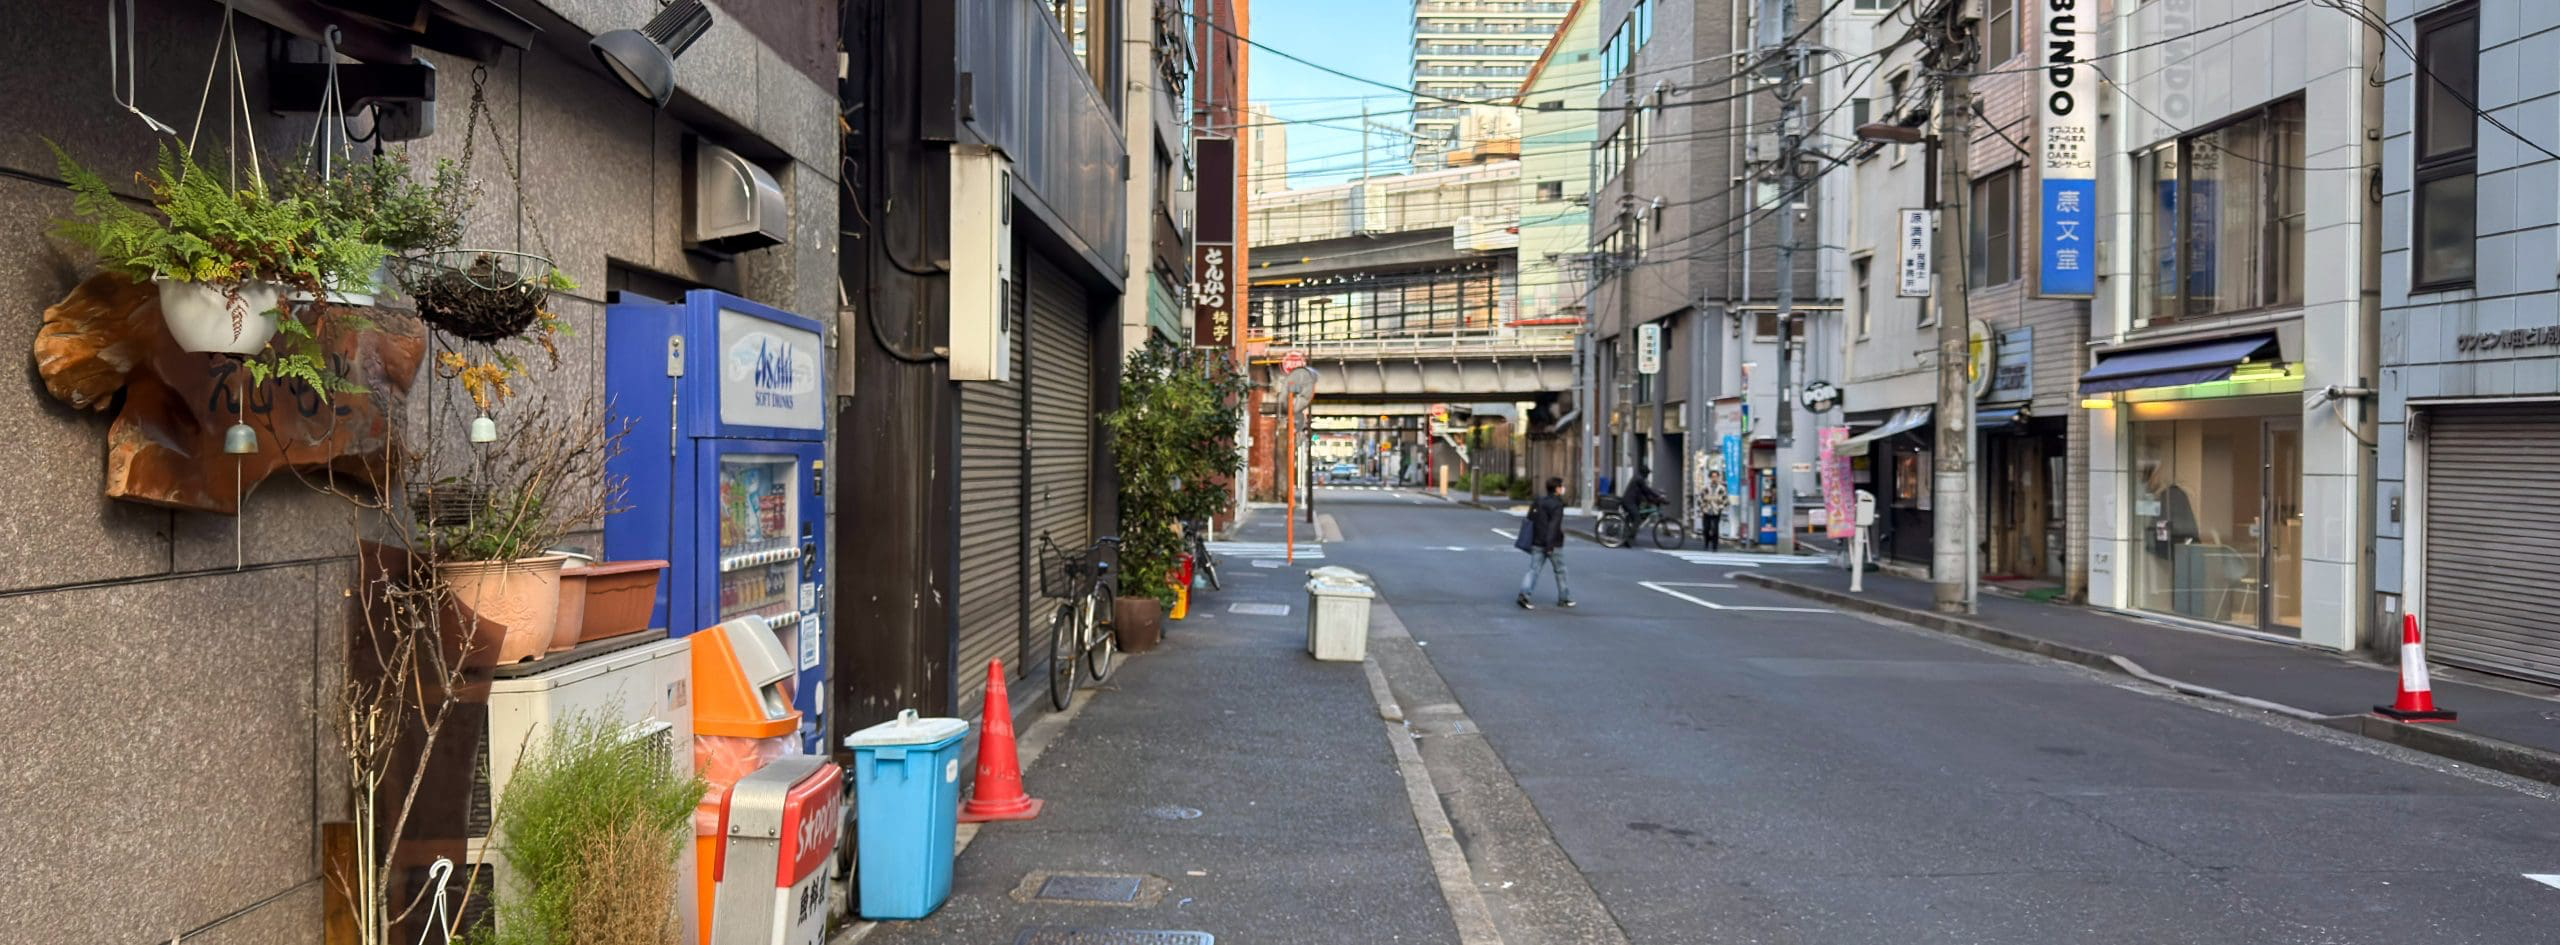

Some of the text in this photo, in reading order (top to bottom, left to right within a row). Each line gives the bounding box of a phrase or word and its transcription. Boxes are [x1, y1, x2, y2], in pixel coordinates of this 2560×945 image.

[1203, 247, 1226, 308] とんかつ
[755, 391, 794, 410] SOFT DRINKS
